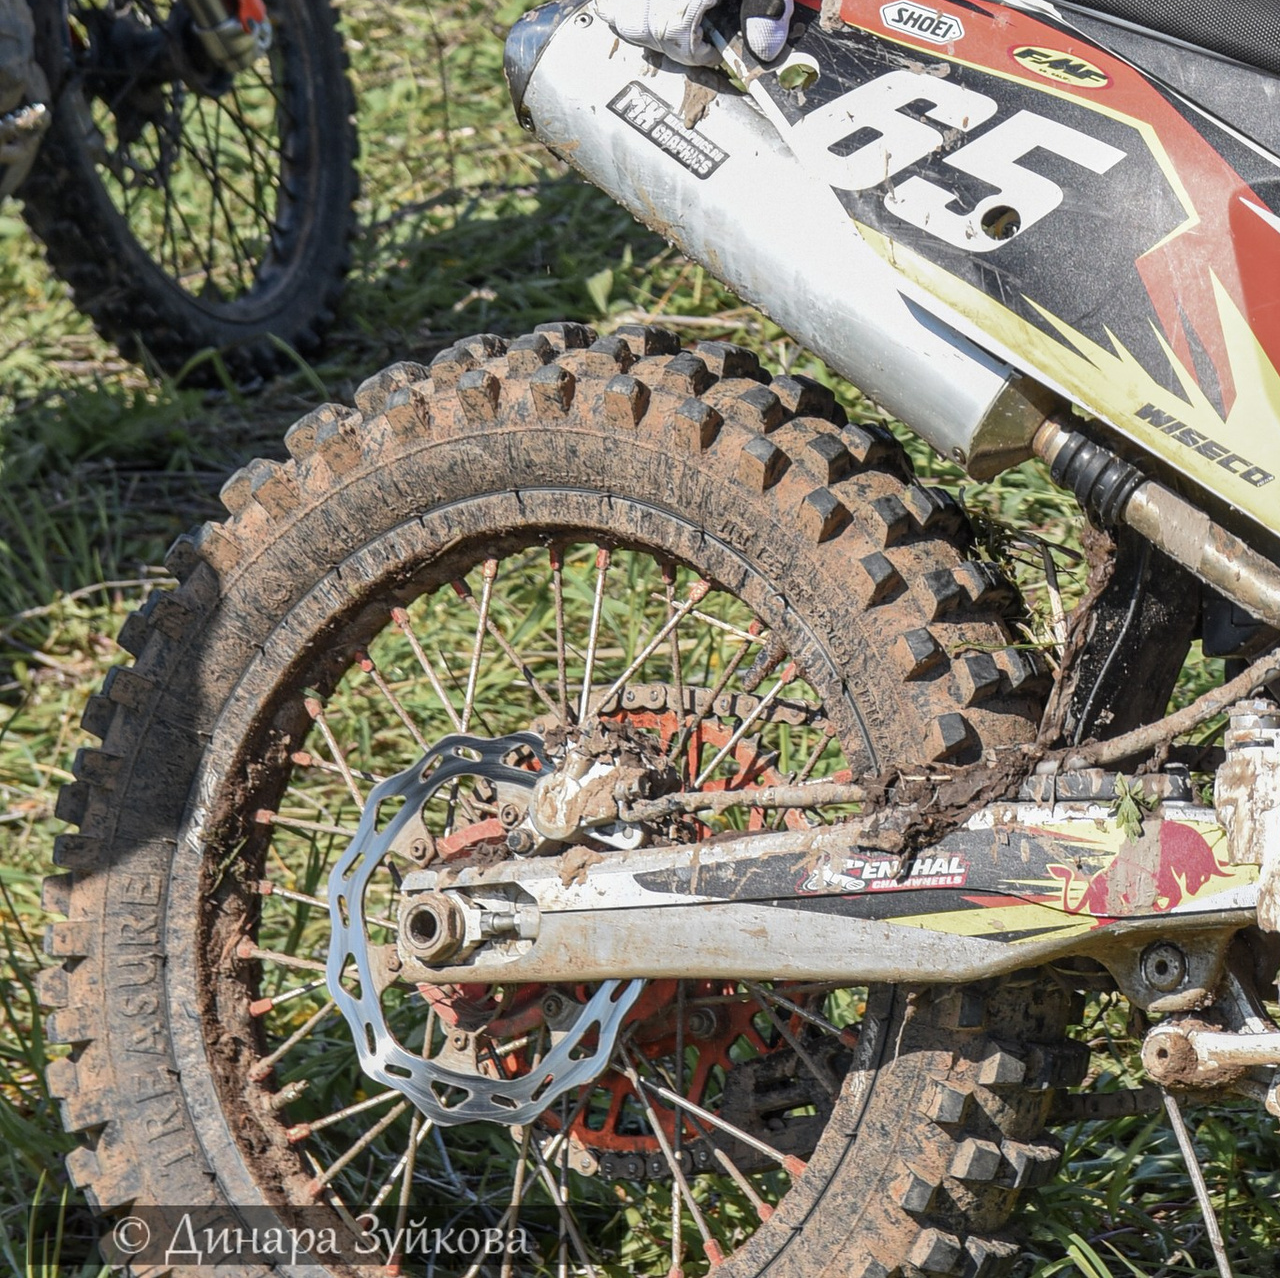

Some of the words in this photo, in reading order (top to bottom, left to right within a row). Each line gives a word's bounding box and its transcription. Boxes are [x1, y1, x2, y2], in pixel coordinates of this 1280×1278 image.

[892, 7, 953, 39] SHOEI
[1014, 48, 1109, 83] FMF
[651, 124, 712, 174] GRAPHICS
[788, 70, 1128, 253] 65
[1134, 402, 1276, 487] WISECO
